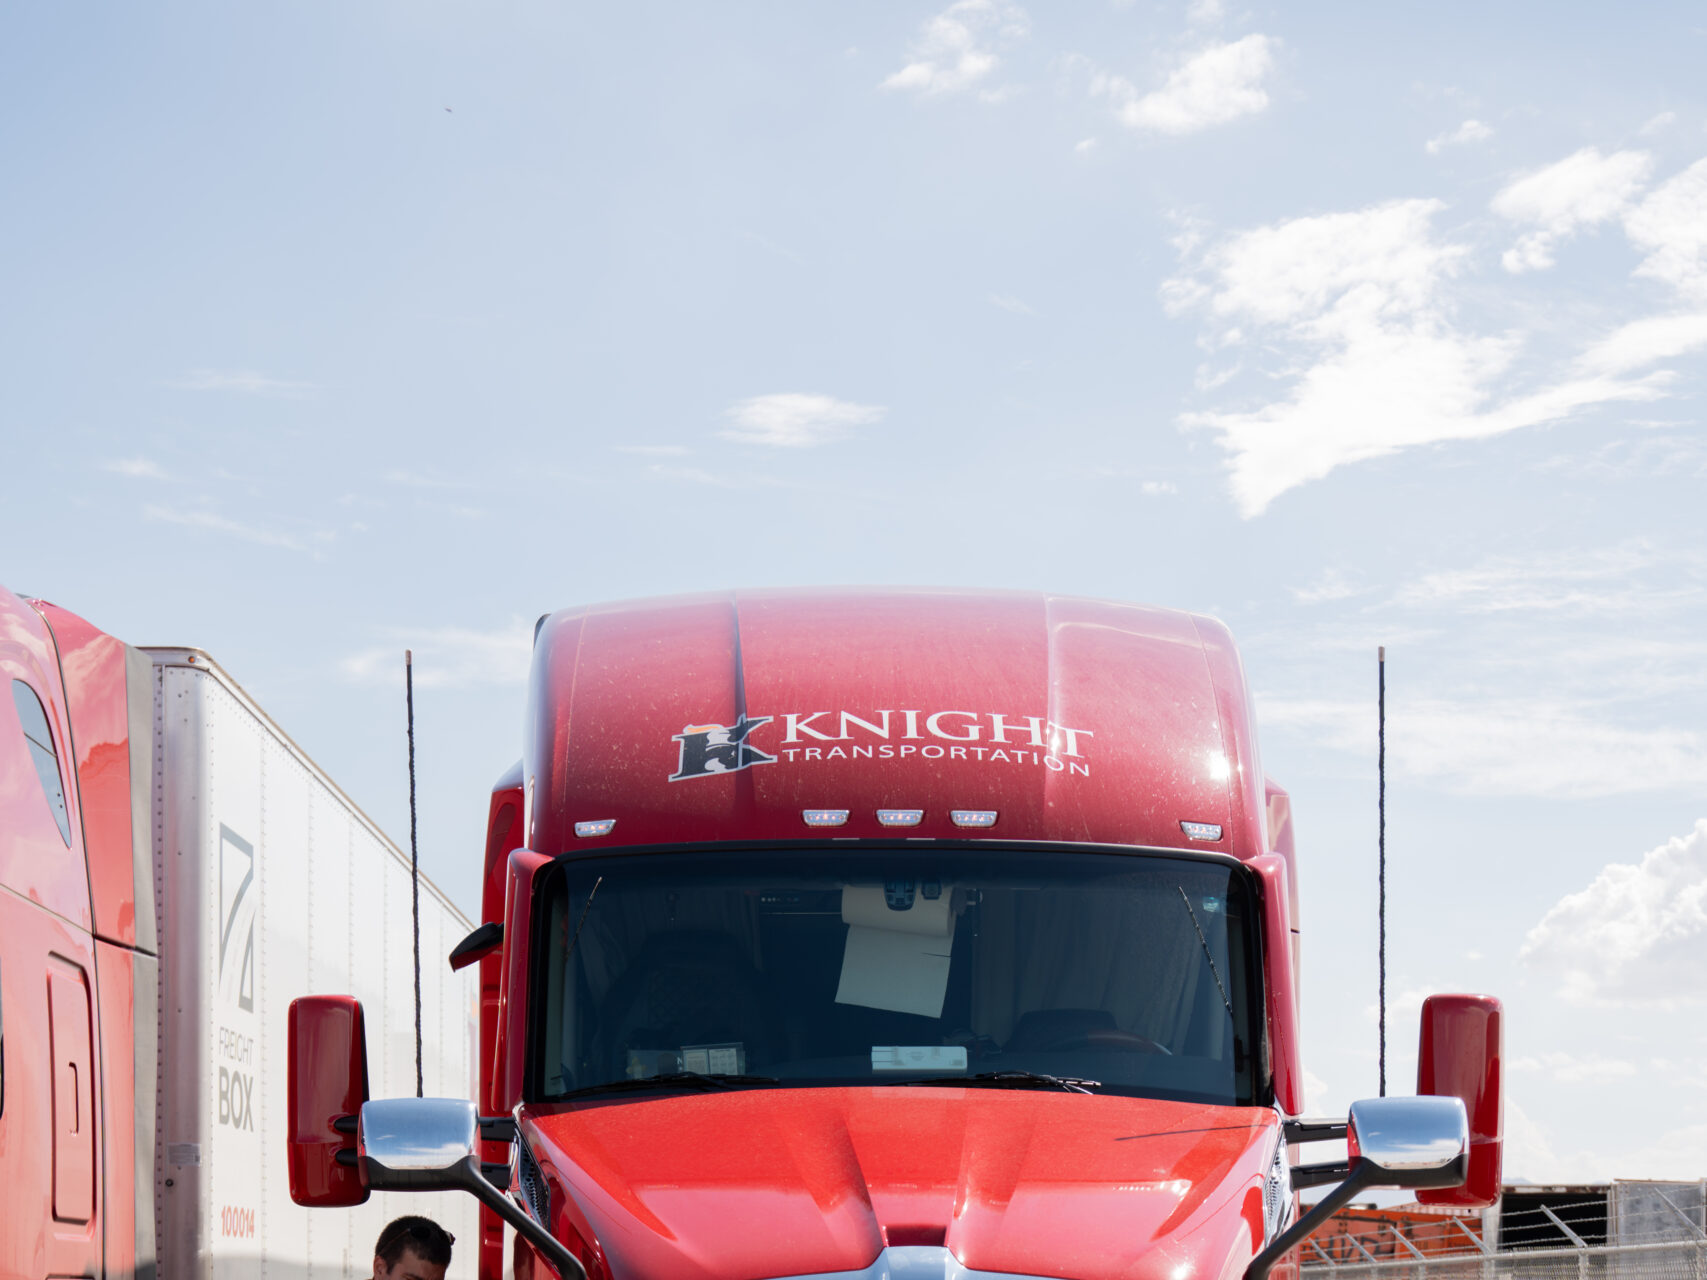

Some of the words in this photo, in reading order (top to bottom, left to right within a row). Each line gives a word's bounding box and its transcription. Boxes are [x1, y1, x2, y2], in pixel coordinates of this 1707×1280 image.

[780, 709, 1094, 758] KNIGHT
[782, 744, 1090, 777] TRANSPORTATION
[219, 1026, 254, 1065] FREIGHT
[219, 1066, 254, 1132] BOX
[221, 1206, 255, 1239] 100014
